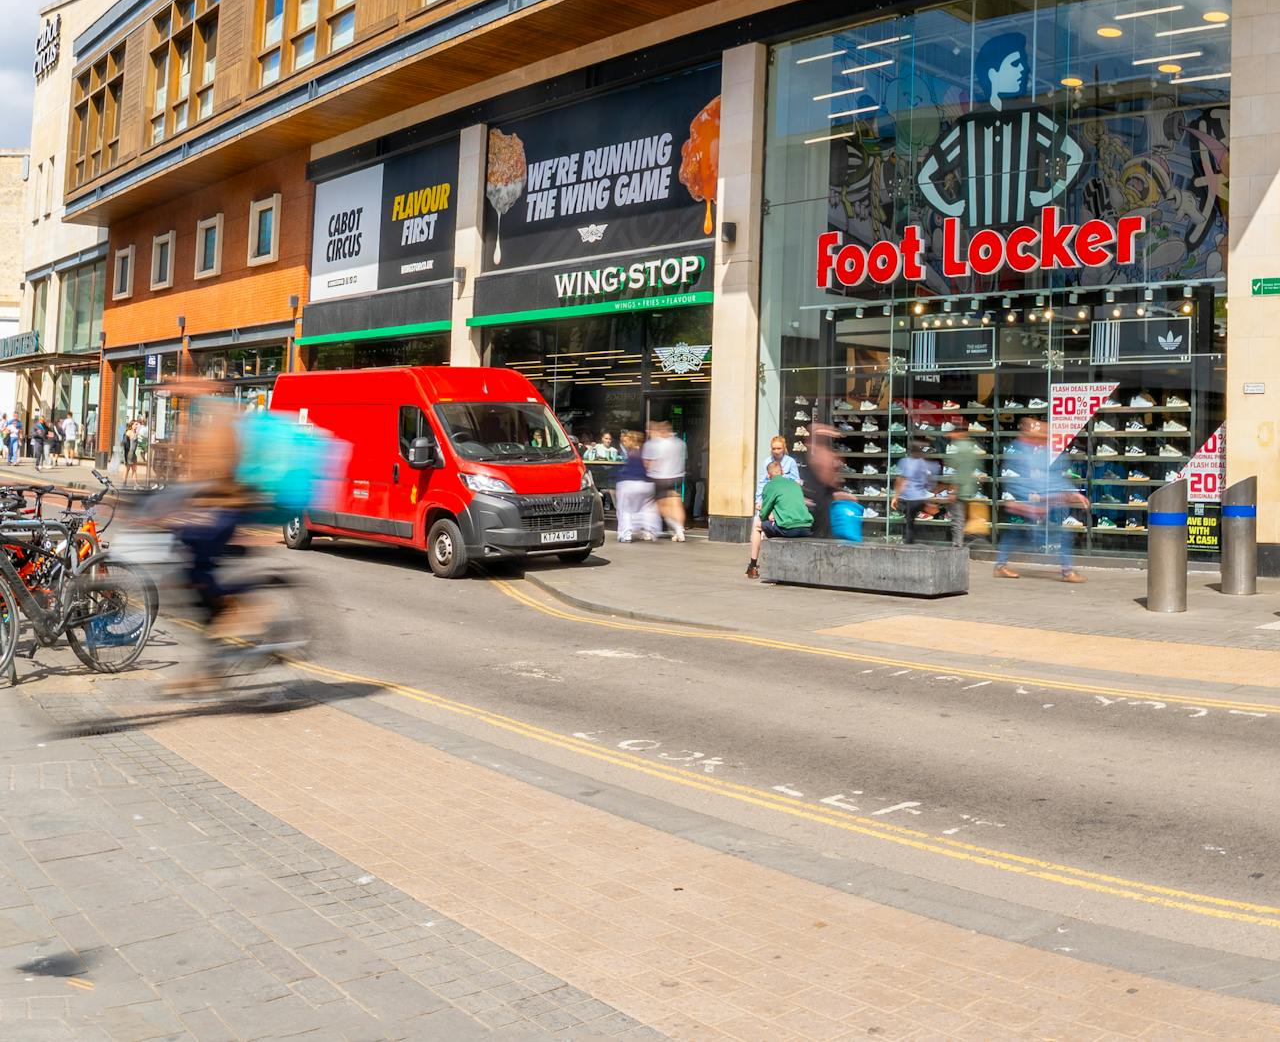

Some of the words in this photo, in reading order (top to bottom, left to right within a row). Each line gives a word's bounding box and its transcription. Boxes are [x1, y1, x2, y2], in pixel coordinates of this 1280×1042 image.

[527, 153, 580, 193] WE'RE
[581, 132, 673, 180] RUNNING
[391, 182, 451, 222] FLAVOUR
[526, 189, 556, 223] THE
[560, 177, 611, 217] WING
[614, 166, 673, 207] GAME
[328, 207, 363, 238] CABOT
[401, 213, 438, 246] FIRST
[326, 232, 363, 263] CIRCUS
[816, 225, 926, 289] Foot
[943, 206, 1146, 277] Locker
[642, 298, 660, 307] FRIES
[666, 295, 697, 304] FLAVOUR
[1053, 397, 1076, 415] 20
[1190, 473, 1217, 493] 20
[1187, 517, 1202, 526] AVE
[1203, 518, 1217, 526] BIG
[1189, 527, 1210, 536] WITH
[1196, 536, 1218, 545] CASH
